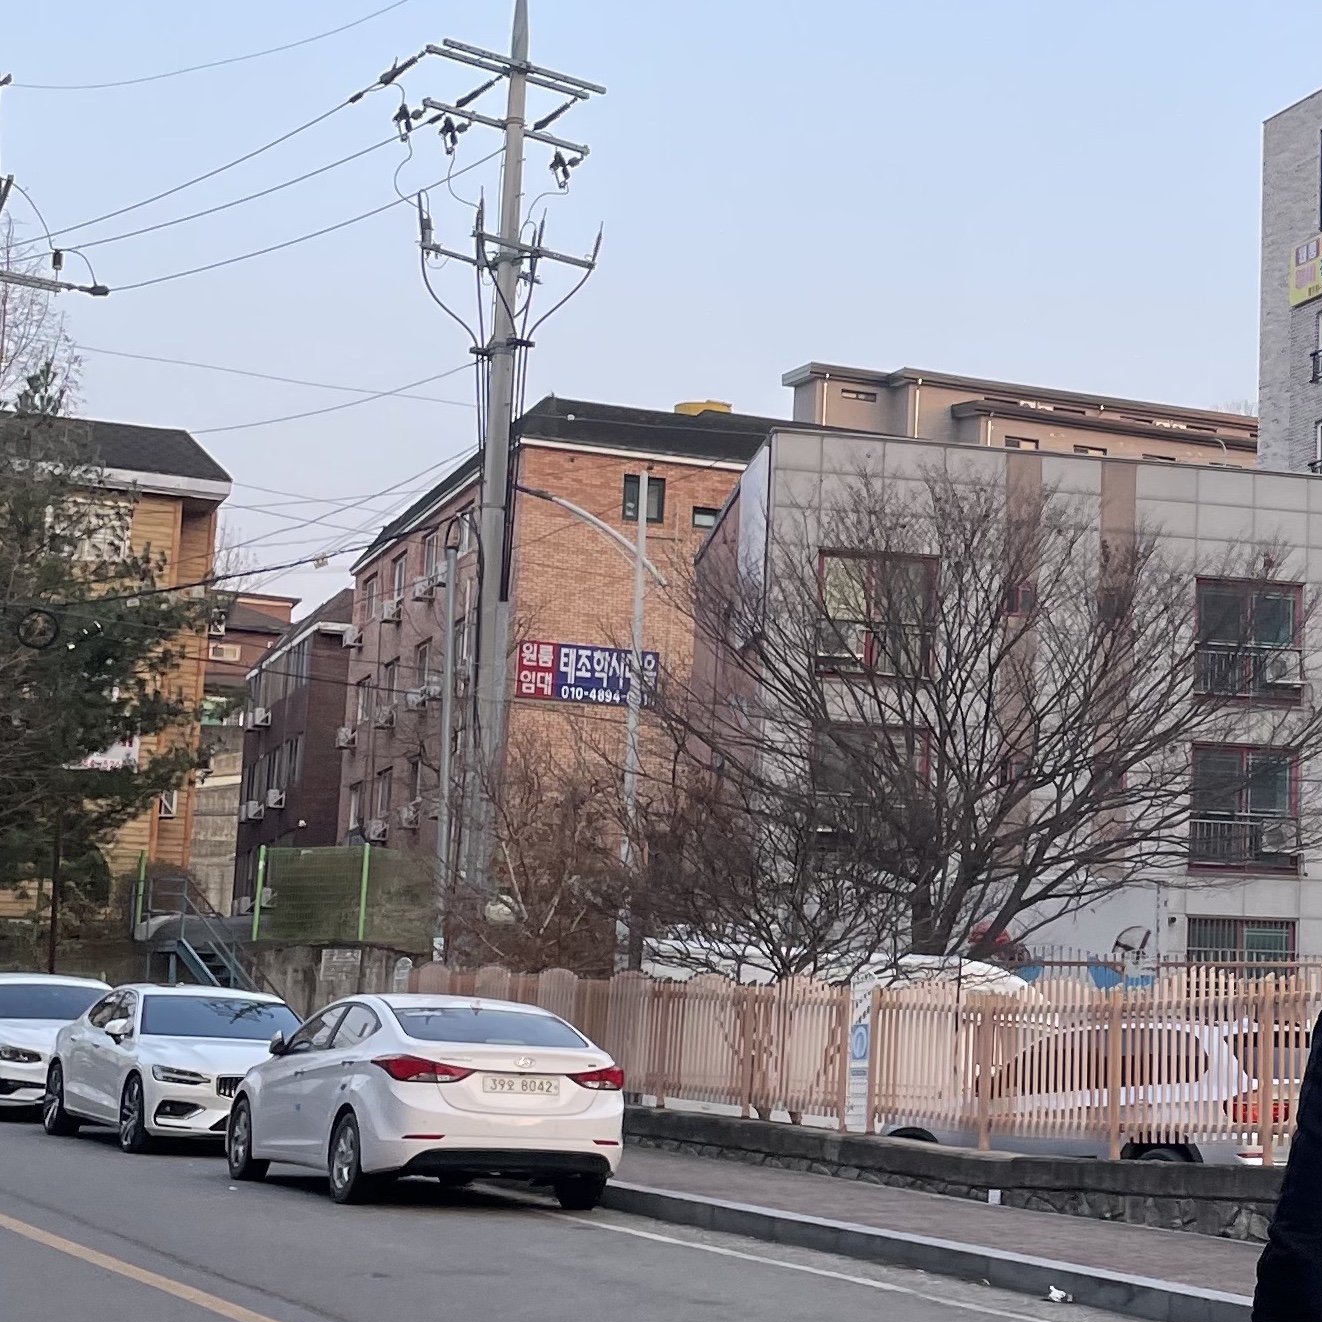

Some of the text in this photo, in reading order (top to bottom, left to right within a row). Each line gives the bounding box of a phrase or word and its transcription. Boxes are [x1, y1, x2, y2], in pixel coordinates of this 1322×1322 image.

[522, 643, 553, 667] 원룸
[520, 670, 552, 695] 임대
[521, 1080, 553, 1093] 8042
